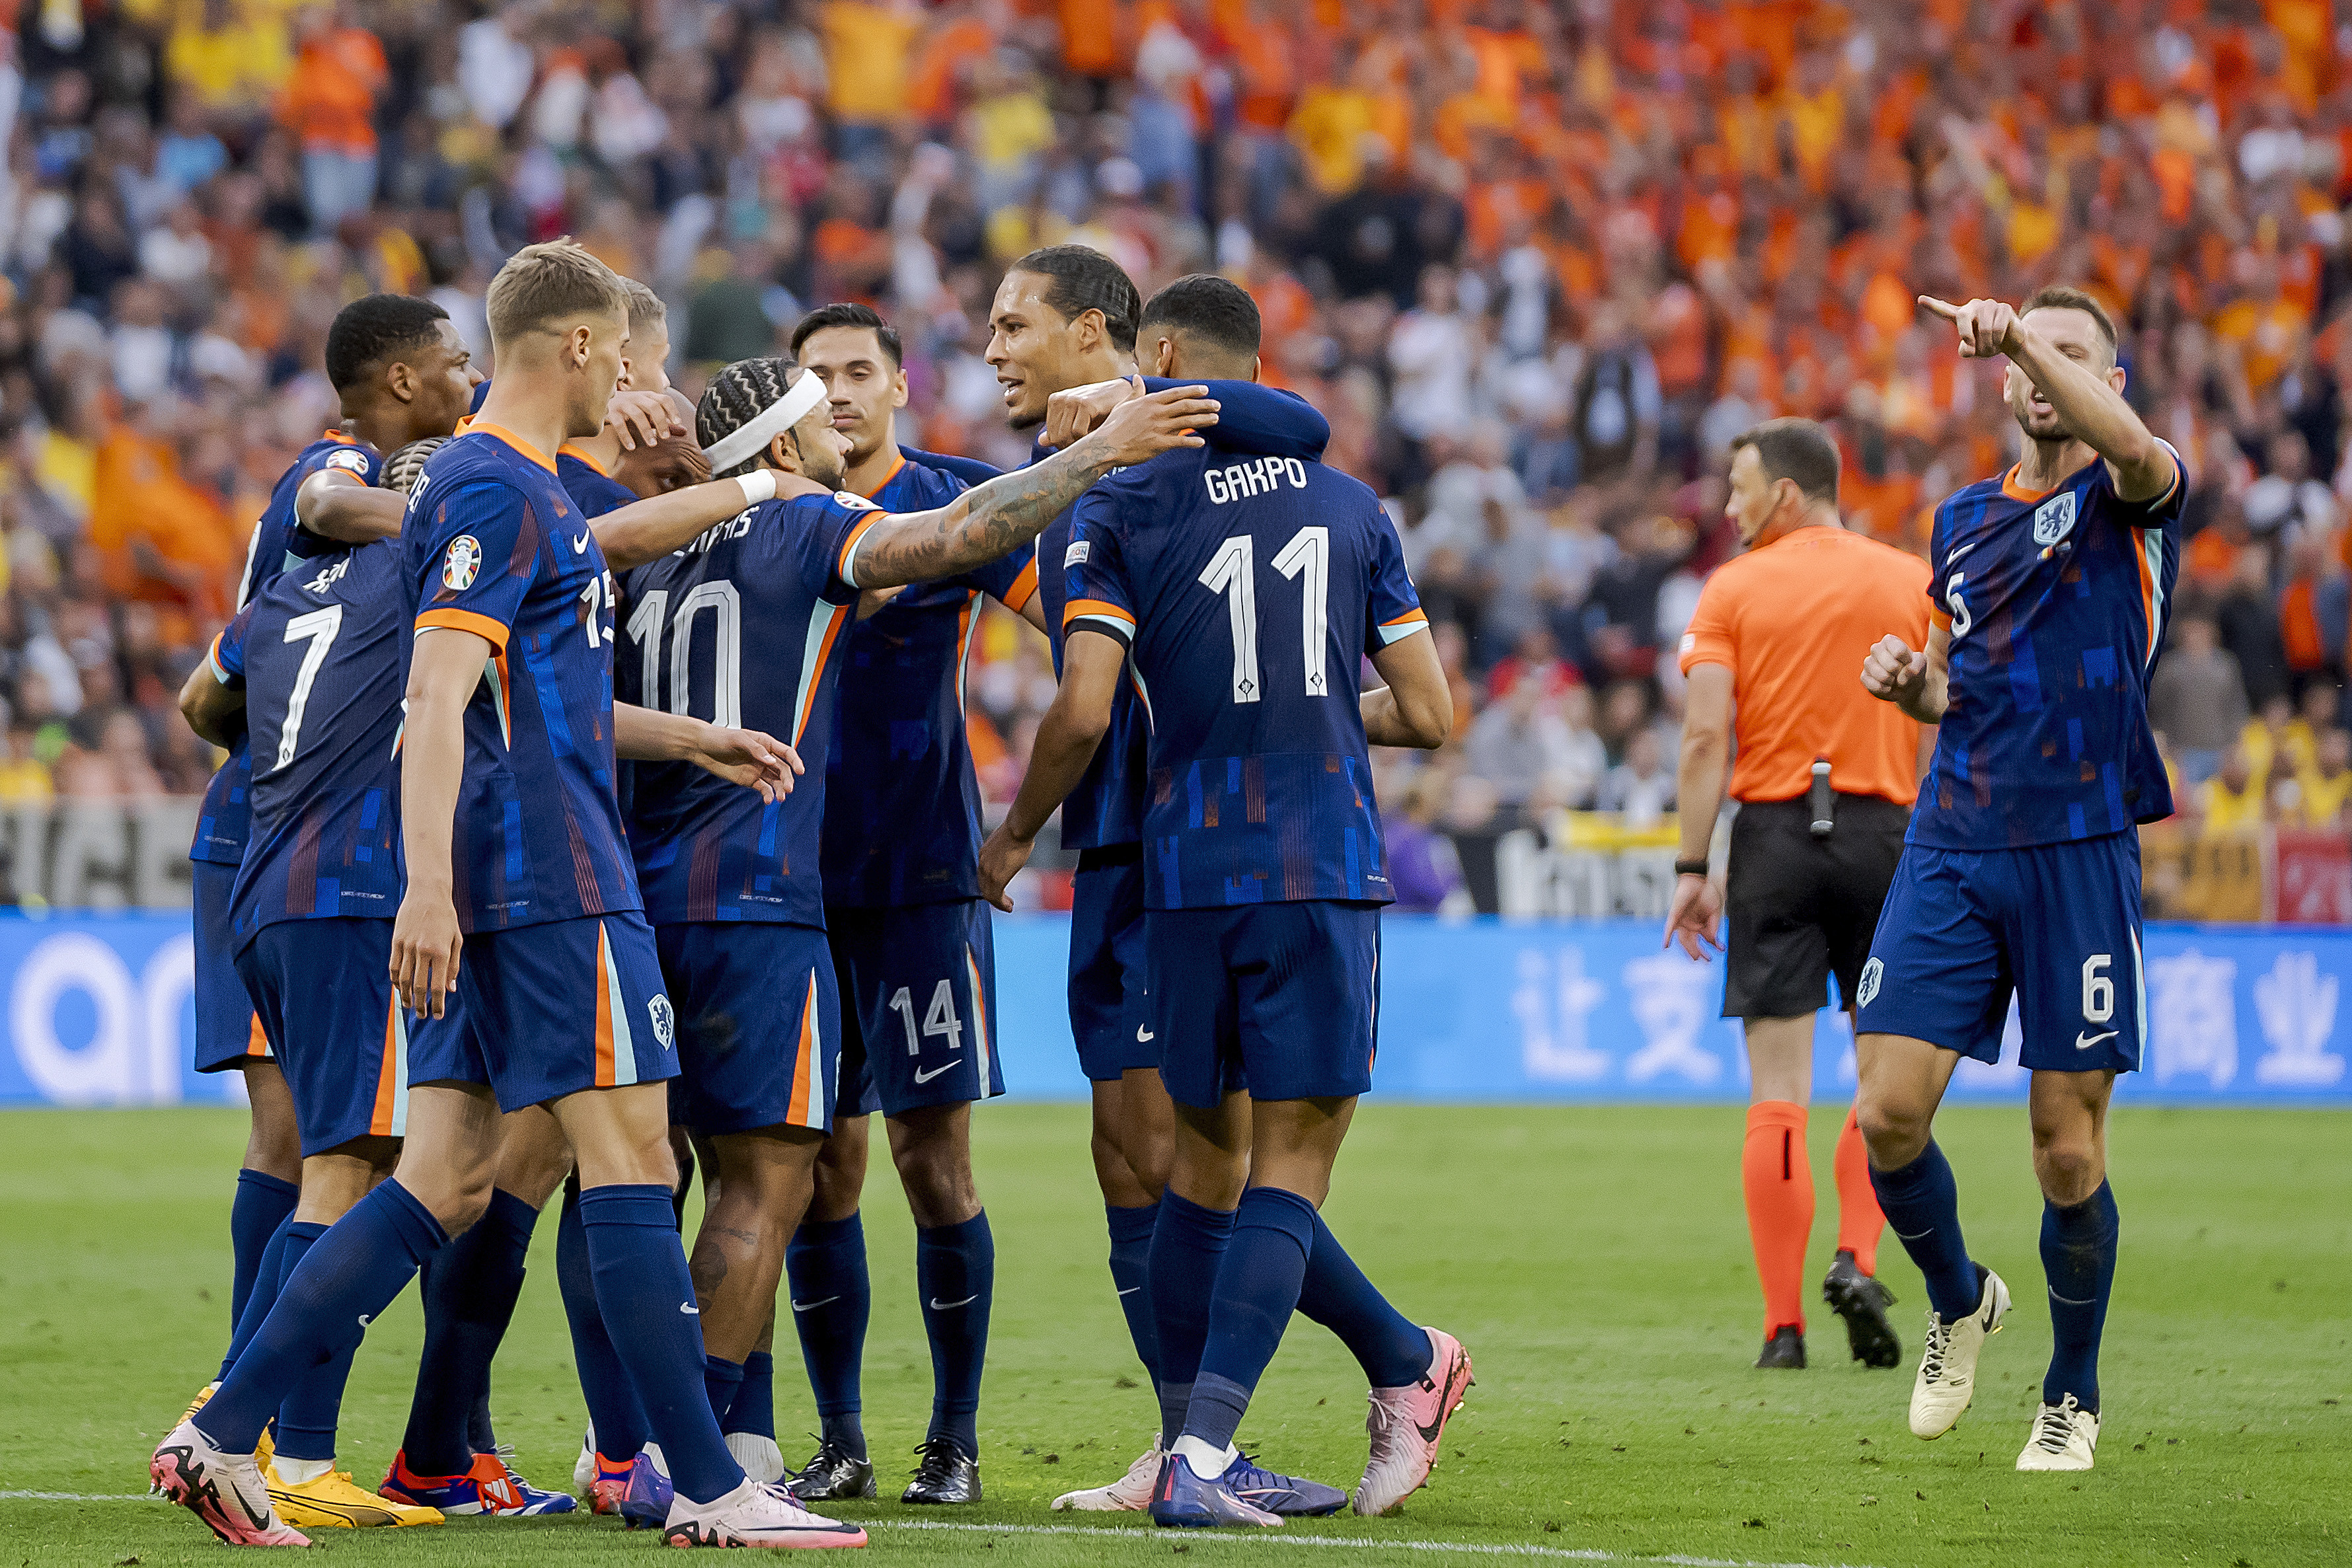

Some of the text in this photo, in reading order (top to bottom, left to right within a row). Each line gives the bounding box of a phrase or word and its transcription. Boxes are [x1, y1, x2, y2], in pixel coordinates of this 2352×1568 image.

[1204, 456, 1308, 504] GAKPO
[626, 579, 741, 730] 10
[1197, 526, 1330, 704] 11
[272, 603, 343, 772] 7
[888, 978, 962, 1057] 14
[2082, 954, 2114, 1024] 6
